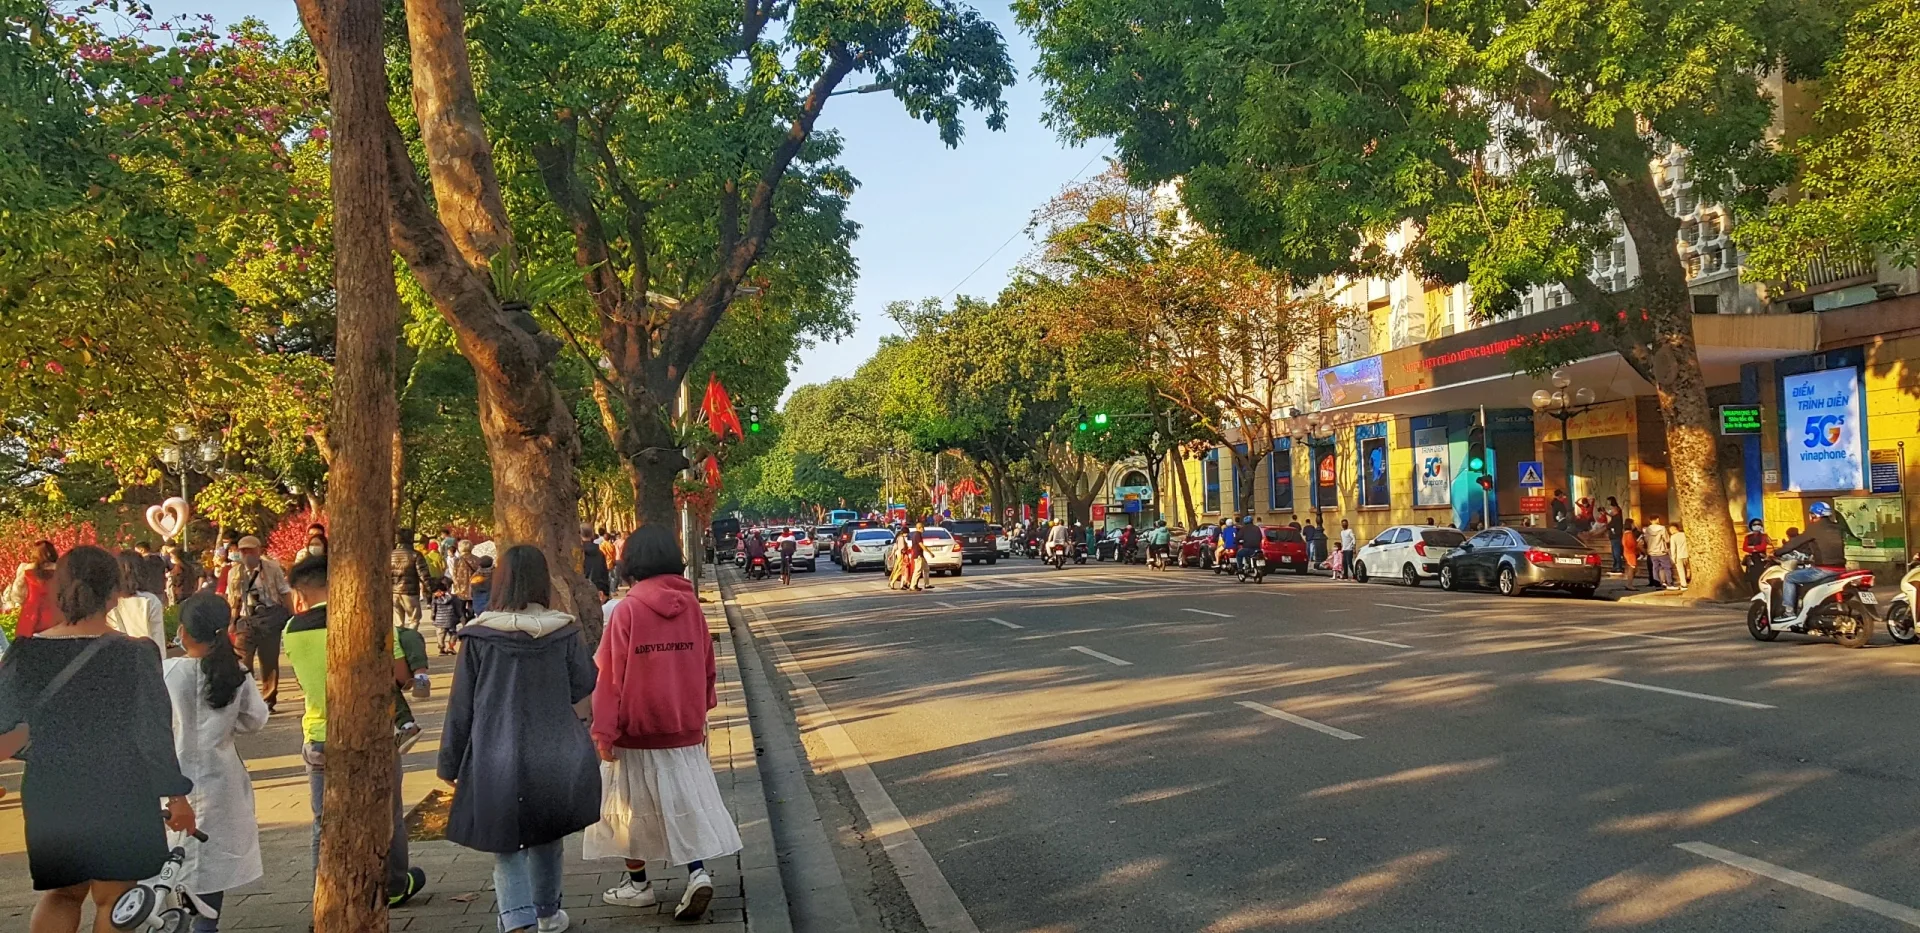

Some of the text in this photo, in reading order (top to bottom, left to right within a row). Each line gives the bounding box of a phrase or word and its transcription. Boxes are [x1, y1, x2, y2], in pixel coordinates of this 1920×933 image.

[1792, 381, 1815, 397] ĐIỂM
[1798, 391, 1850, 411] TRÌNH DIỄN
[1800, 449, 1847, 462] vinaphone
[635, 642, 694, 655] &DEVELOPMENT
